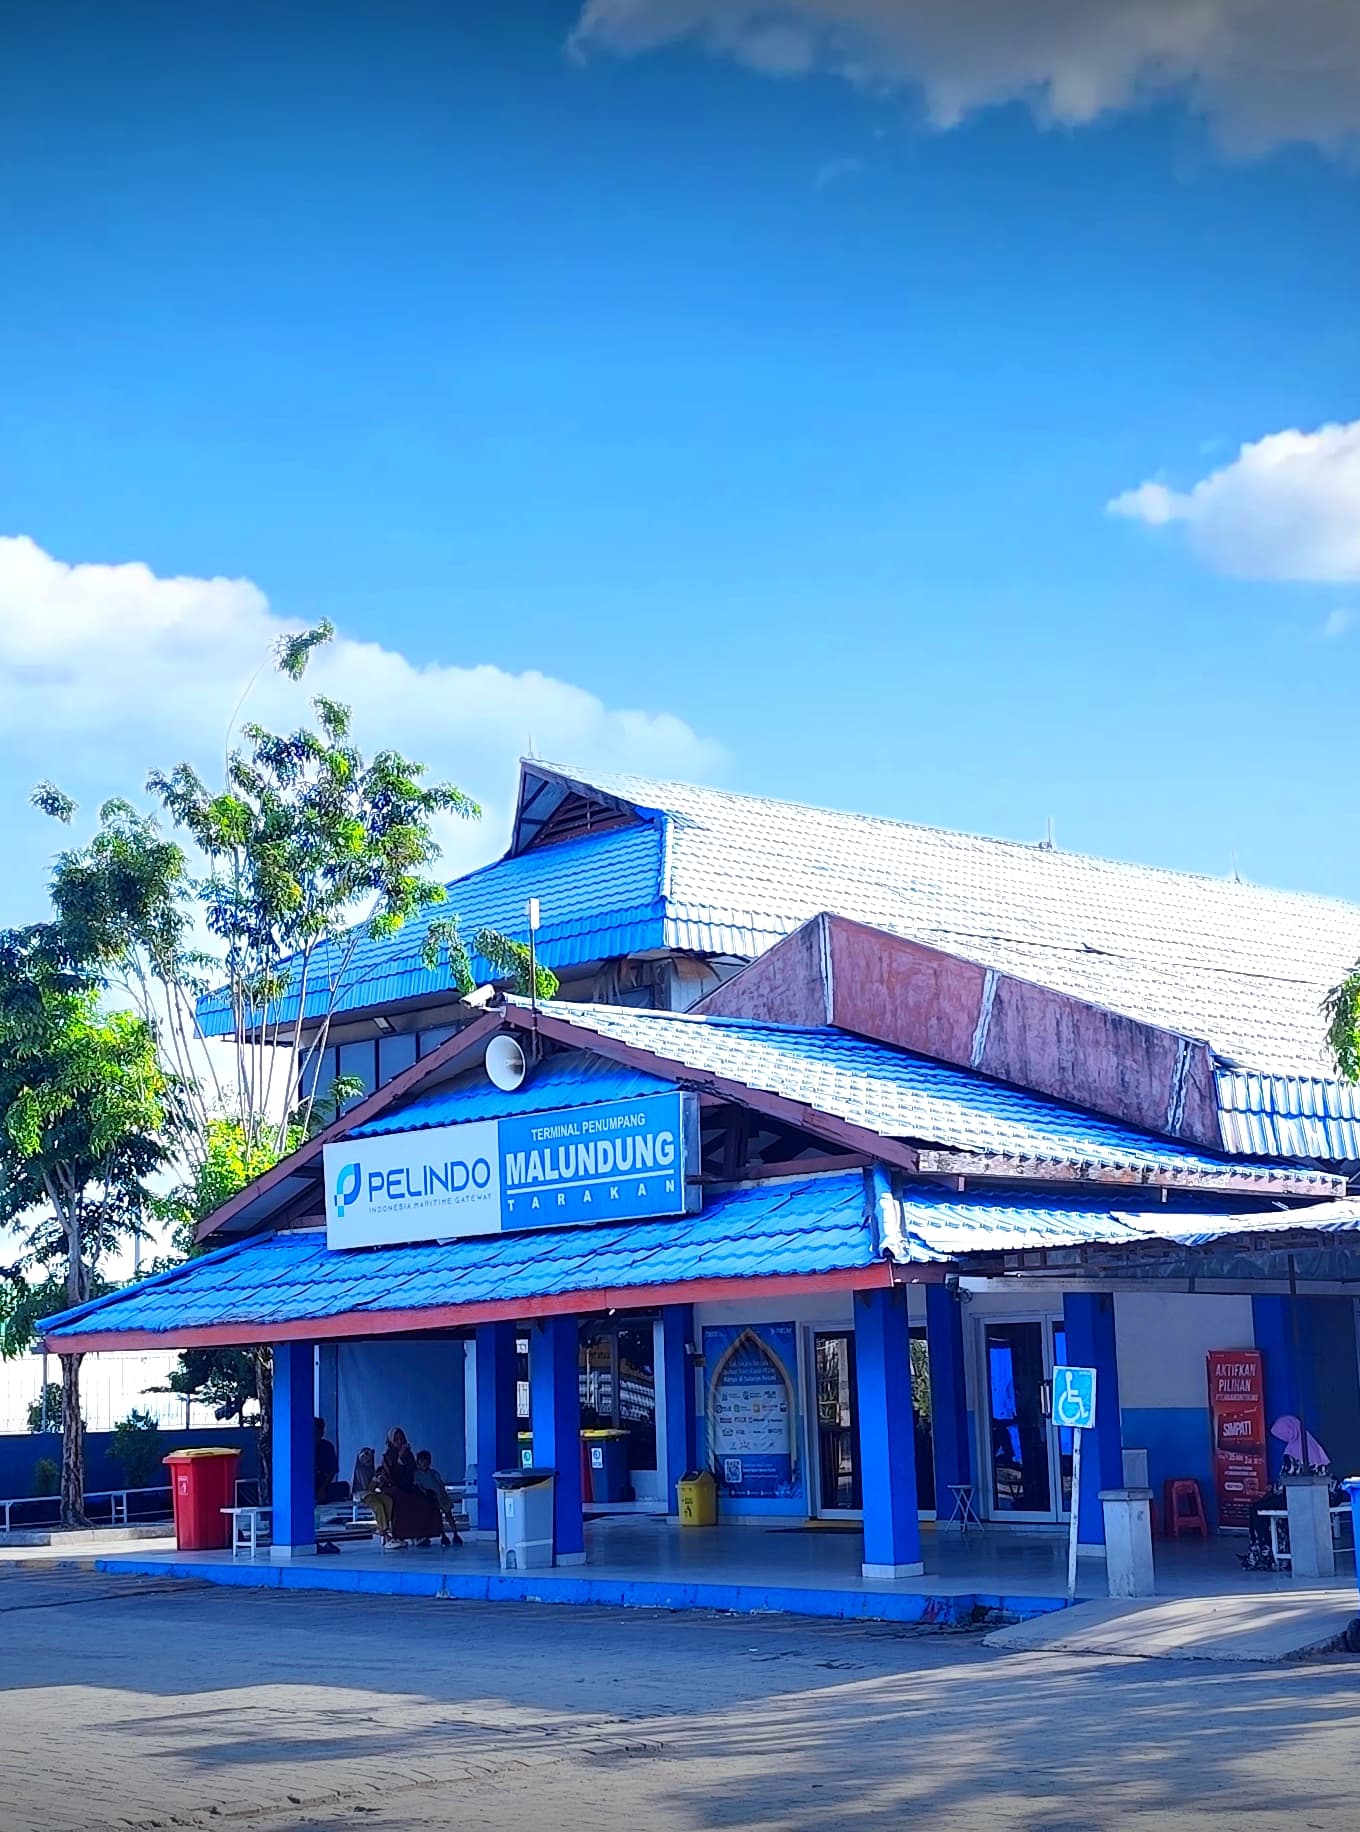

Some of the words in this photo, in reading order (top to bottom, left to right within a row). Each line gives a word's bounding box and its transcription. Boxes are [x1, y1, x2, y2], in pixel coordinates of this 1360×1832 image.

[531, 1123, 580, 1141] TERMINAL
[582, 1113, 646, 1135] PENUMPANG
[506, 1131, 675, 1186] MALUNDUNG
[368, 1157, 491, 1203] PELINDO
[369, 1202, 411, 1214] INDONESIA
[414, 1197, 452, 1209] MARITIME
[455, 1193, 492, 1204] GATEWAY
[507, 1180, 675, 1212] TARAKAN
[1215, 1363, 1256, 1377] AKTIFKAN
[1218, 1378, 1251, 1392] PILIHAN
[1222, 1420, 1252, 1437] SIMPATI
